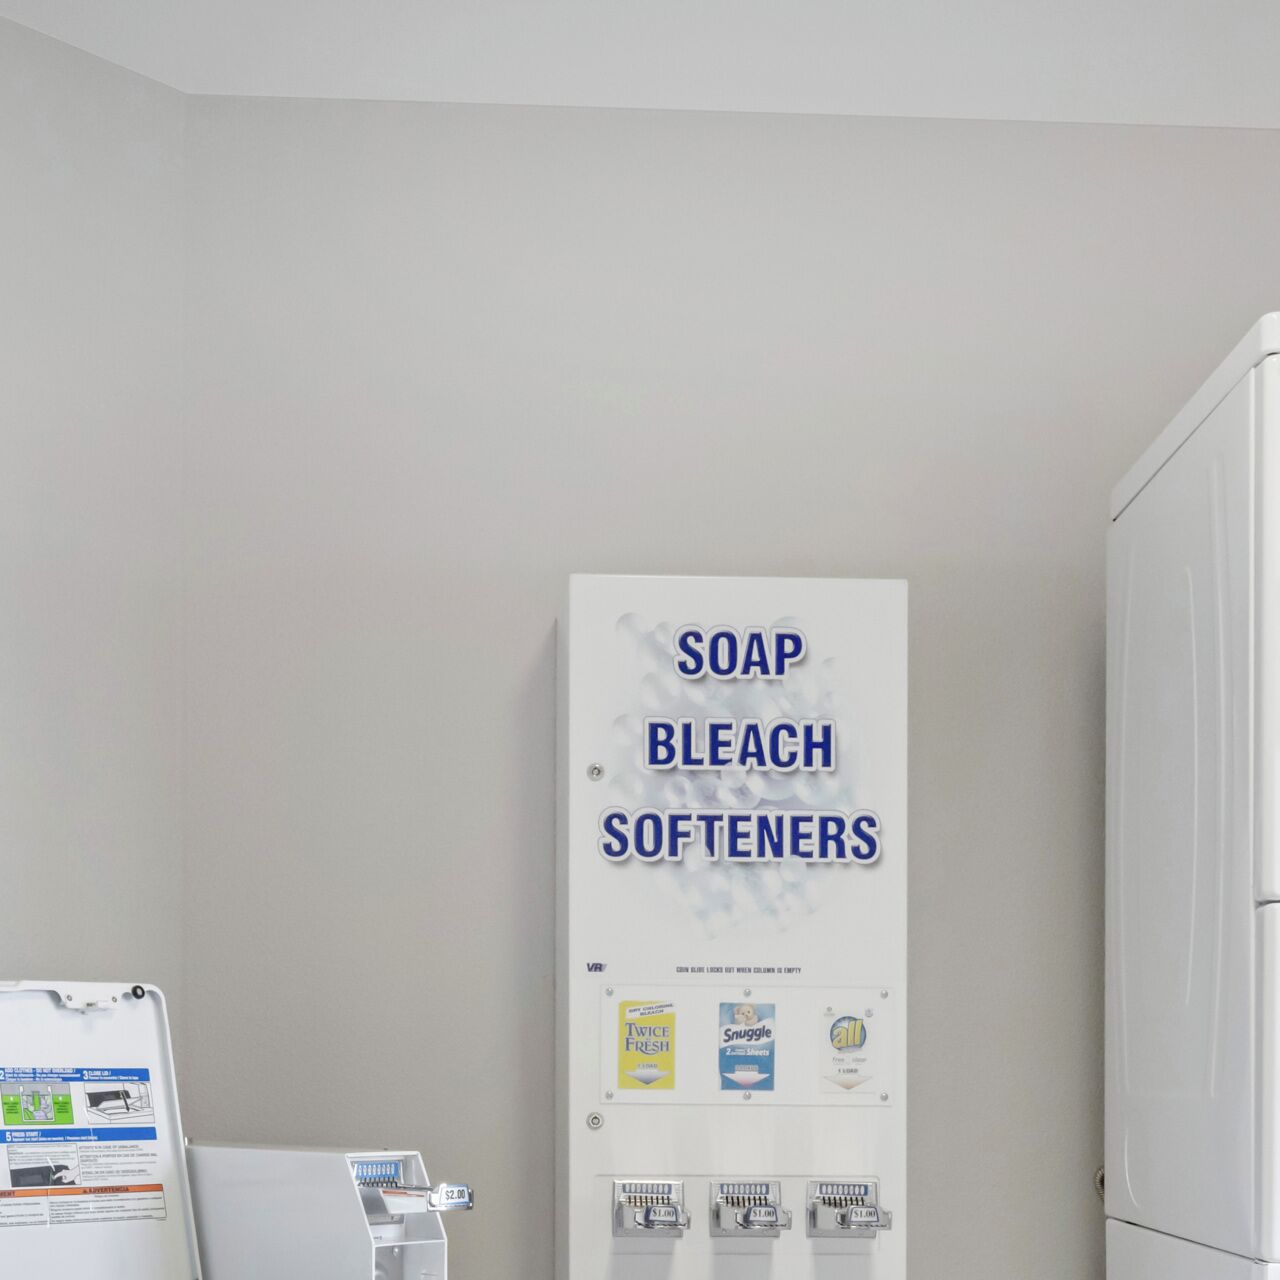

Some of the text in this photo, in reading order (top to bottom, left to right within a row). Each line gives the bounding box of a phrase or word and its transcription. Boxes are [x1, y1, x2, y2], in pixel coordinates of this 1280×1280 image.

[678, 630, 802, 676] SOAP
[648, 722, 831, 768] BLEACH
[602, 812, 878, 860] SOFTENERS
[625, 1023, 669, 1037] TWICE
[723, 1025, 771, 1043] Snuggle
[833, 1019, 863, 1049] all
[625, 1037, 669, 1055] FRESH
[0, 1070, 4, 1080] 2
[83, 1071, 89, 1080] 3
[6, 1132, 11, 1141] 5
[445, 1189, 465, 1200] $2.00
[652, 1208, 674, 1218] $1.00
[752, 1208, 774, 1218] $1.00
[853, 1209, 876, 1218] $1.00
